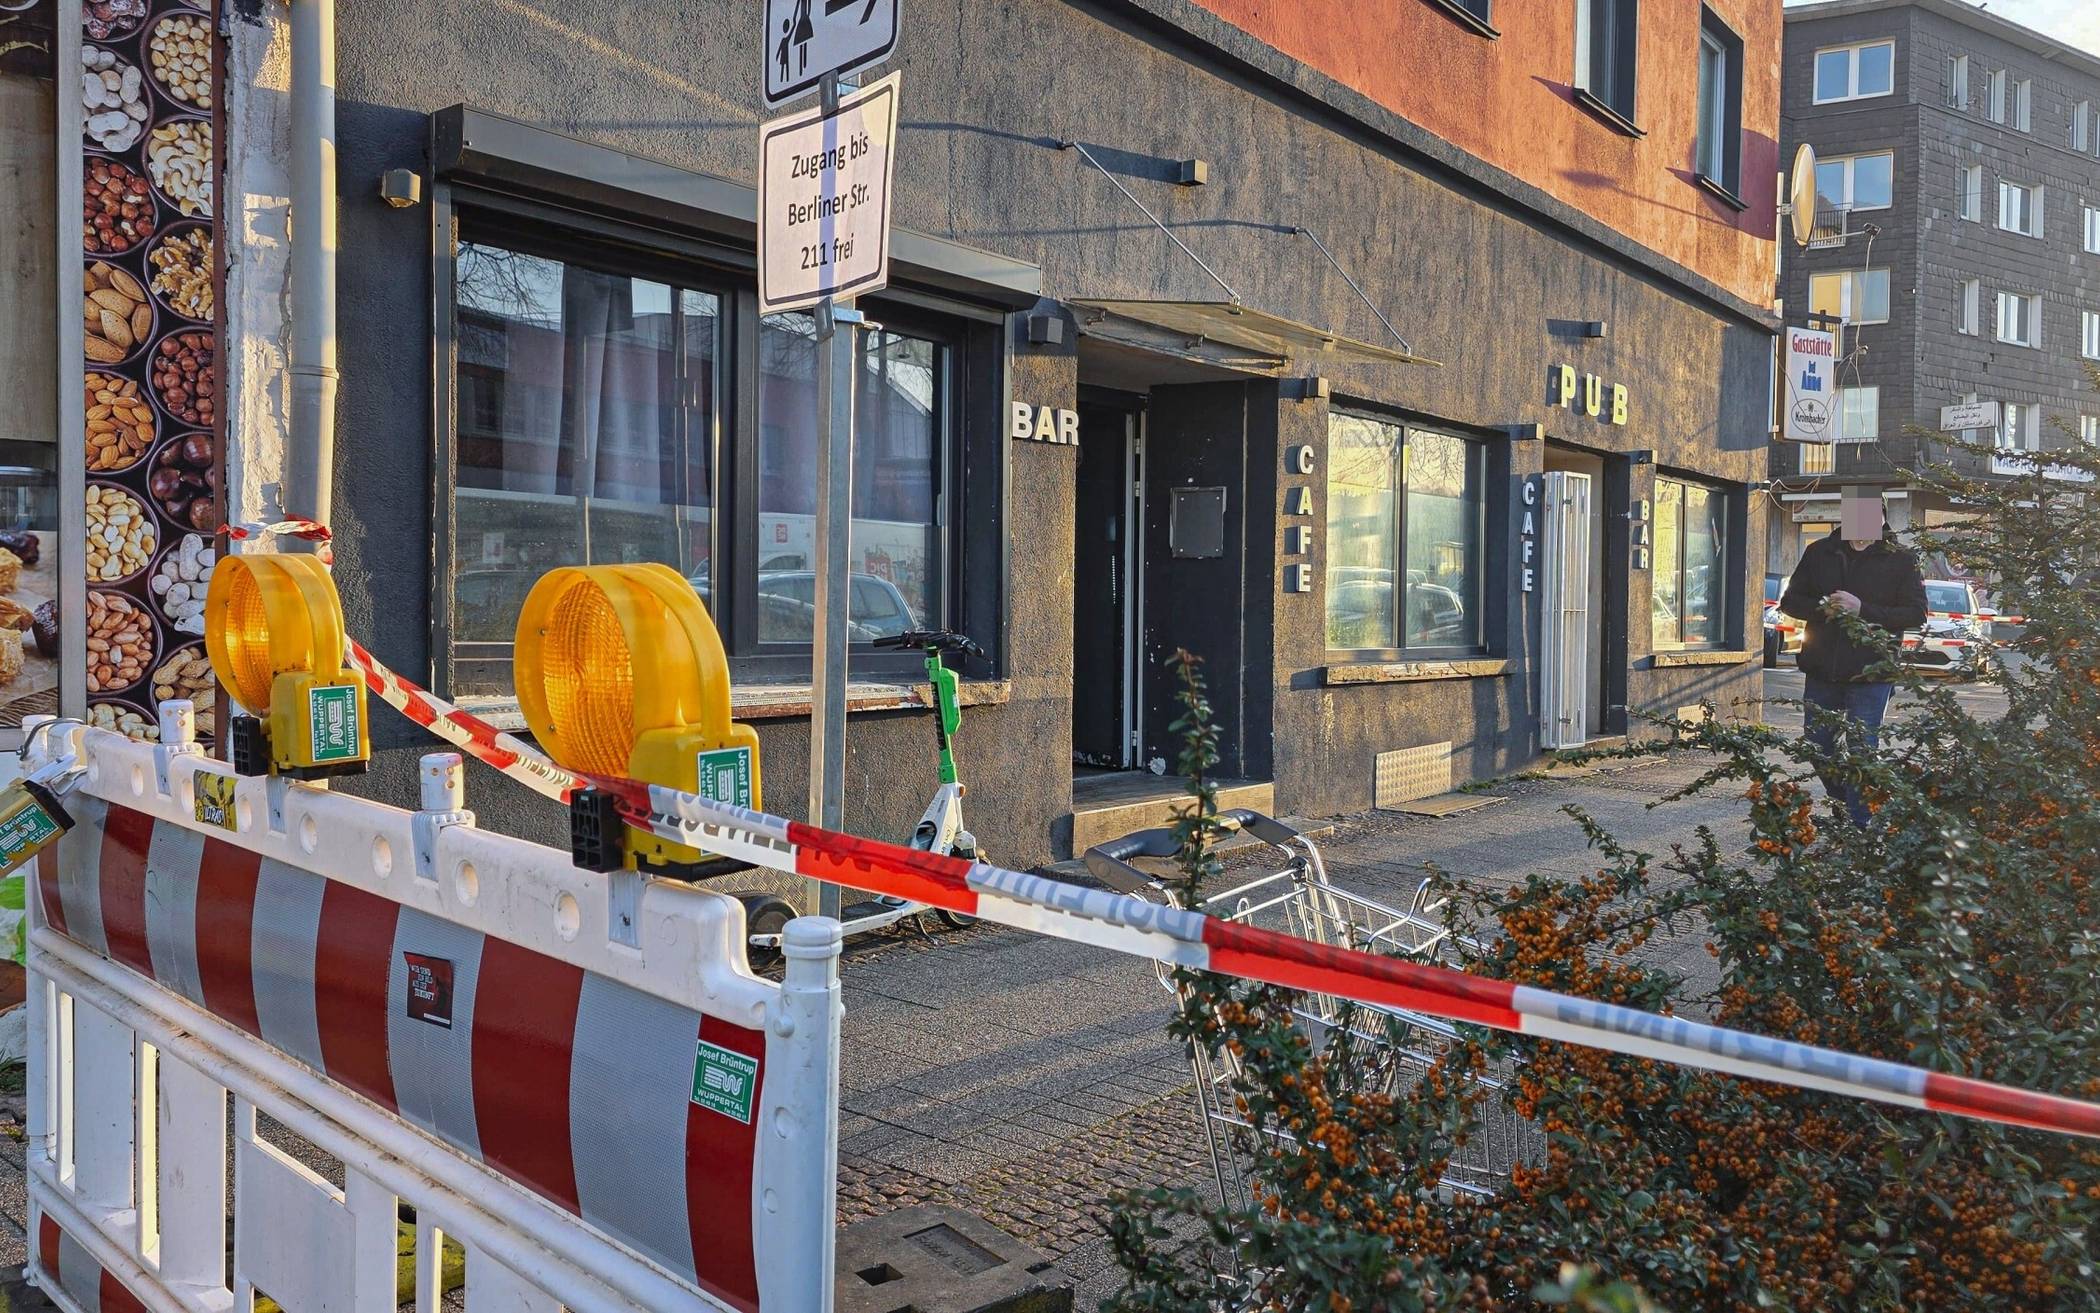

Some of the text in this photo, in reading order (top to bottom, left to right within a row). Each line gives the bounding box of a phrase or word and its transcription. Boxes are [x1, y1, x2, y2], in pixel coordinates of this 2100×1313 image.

[791, 131, 869, 179] Zugang bis
[788, 183, 870, 227] Berliner Str.
[801, 233, 854, 270] 211 frei
[1792, 334, 1832, 357] Gaststätte
[1561, 363, 1629, 426] PUB
[1011, 400, 1080, 446] BAR
[1297, 445, 1315, 592] CAFE
[1521, 481, 1536, 592] CAFE
[1640, 500, 1650, 570] BAR
[317, 695, 326, 754] WUPPERTAL
[346, 688, 357, 755] Josef Brüntrup
[738, 751, 748, 786] Josef
[698, 1046, 754, 1076] Josef Brüntrup
[697, 1087, 745, 1113] WUPPERTAL
